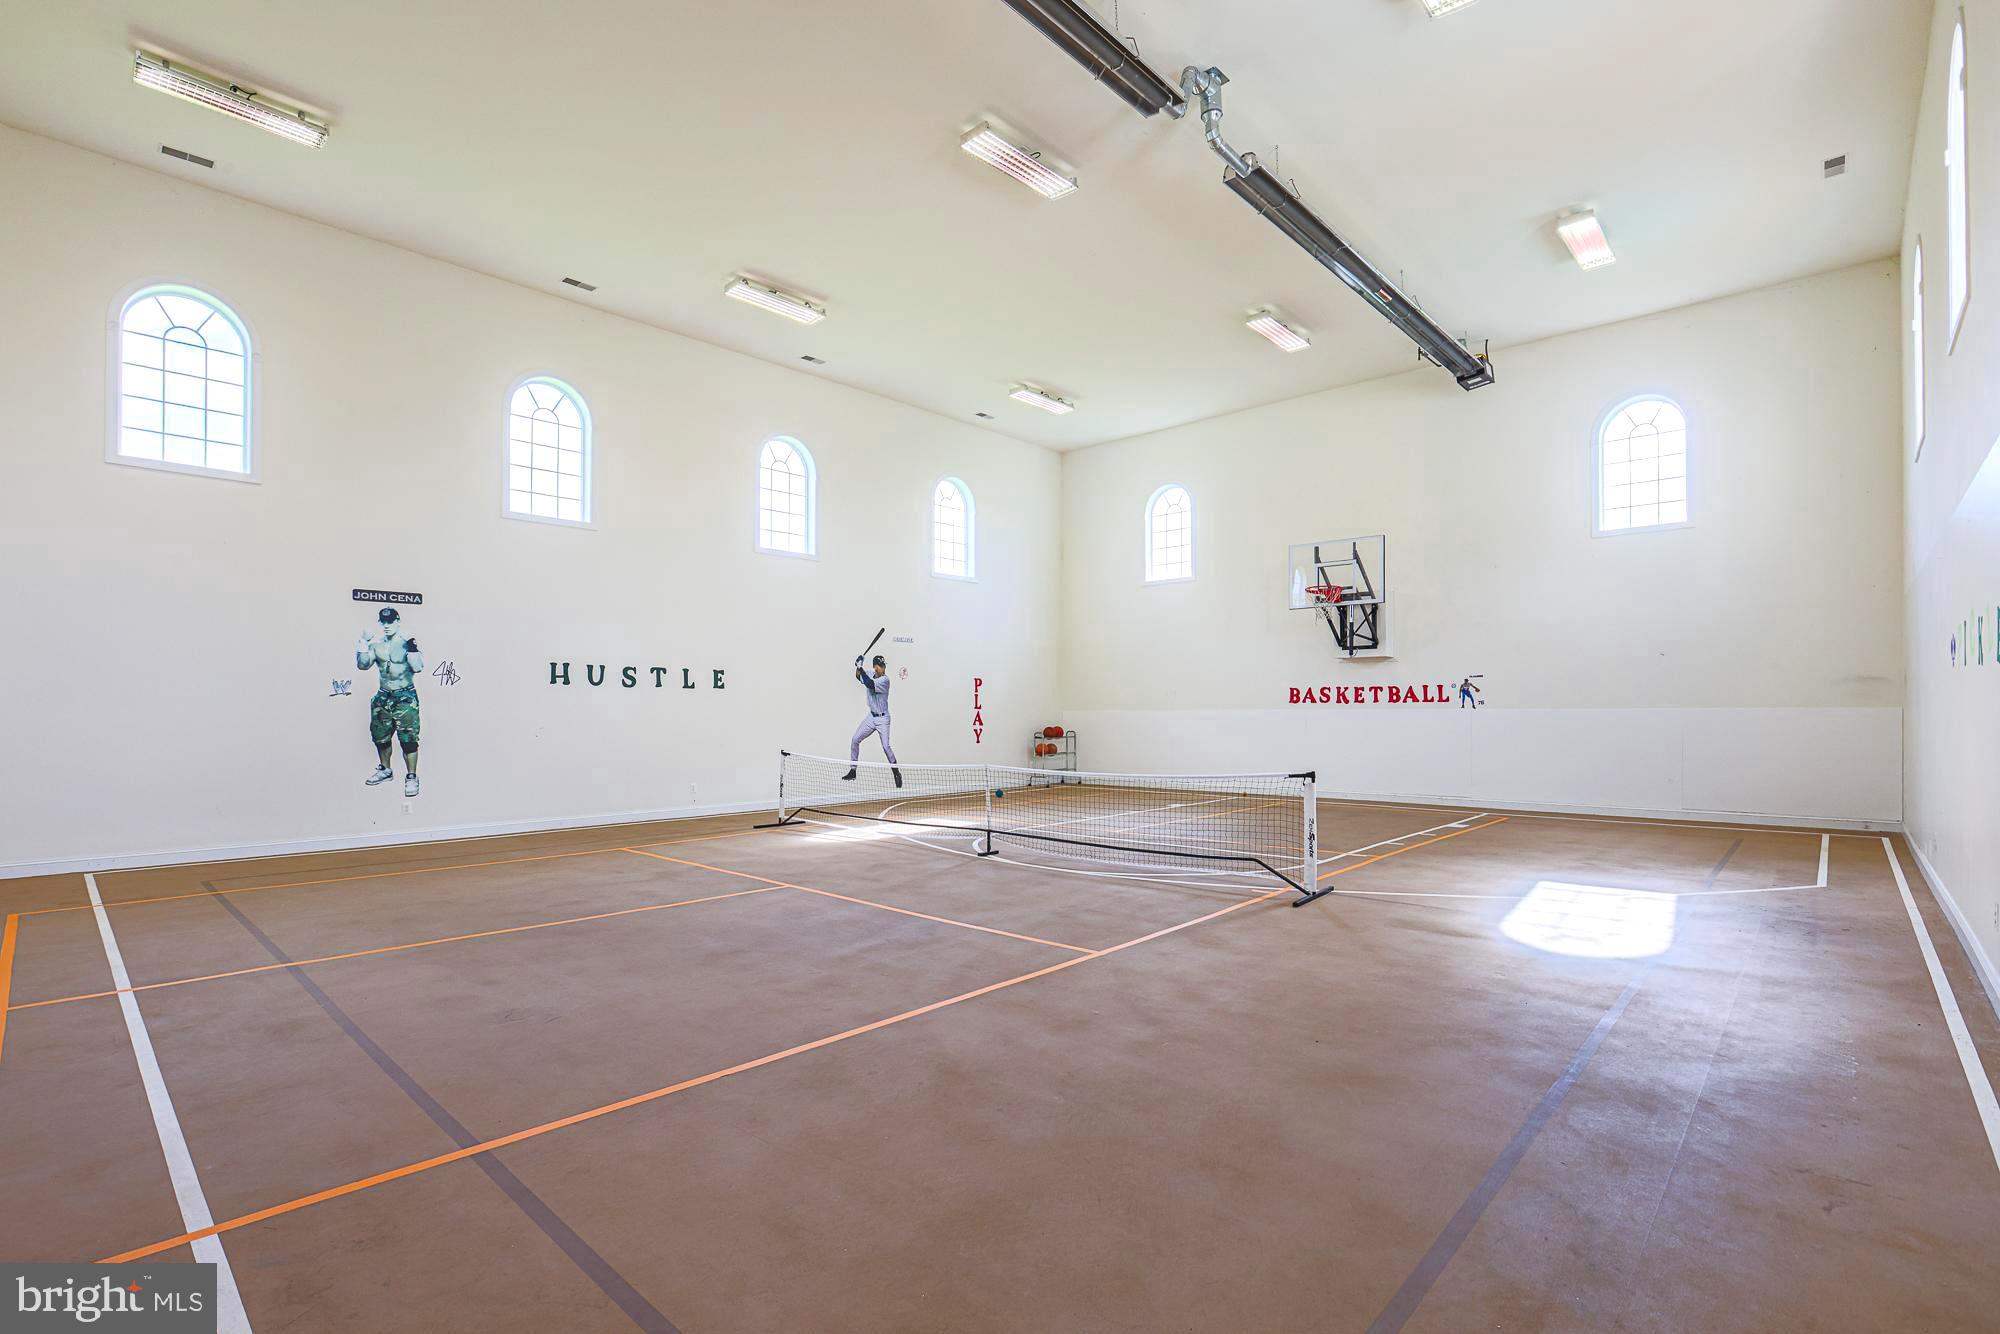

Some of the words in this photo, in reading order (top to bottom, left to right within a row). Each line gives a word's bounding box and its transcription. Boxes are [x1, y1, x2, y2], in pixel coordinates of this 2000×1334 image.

[354, 591, 387, 601] JOHN
[389, 593, 421, 603] CENA
[549, 662, 725, 689] HUSTLE
[1288, 684, 1450, 704] BASKETBALL
[973, 677, 984, 744] PLAY
